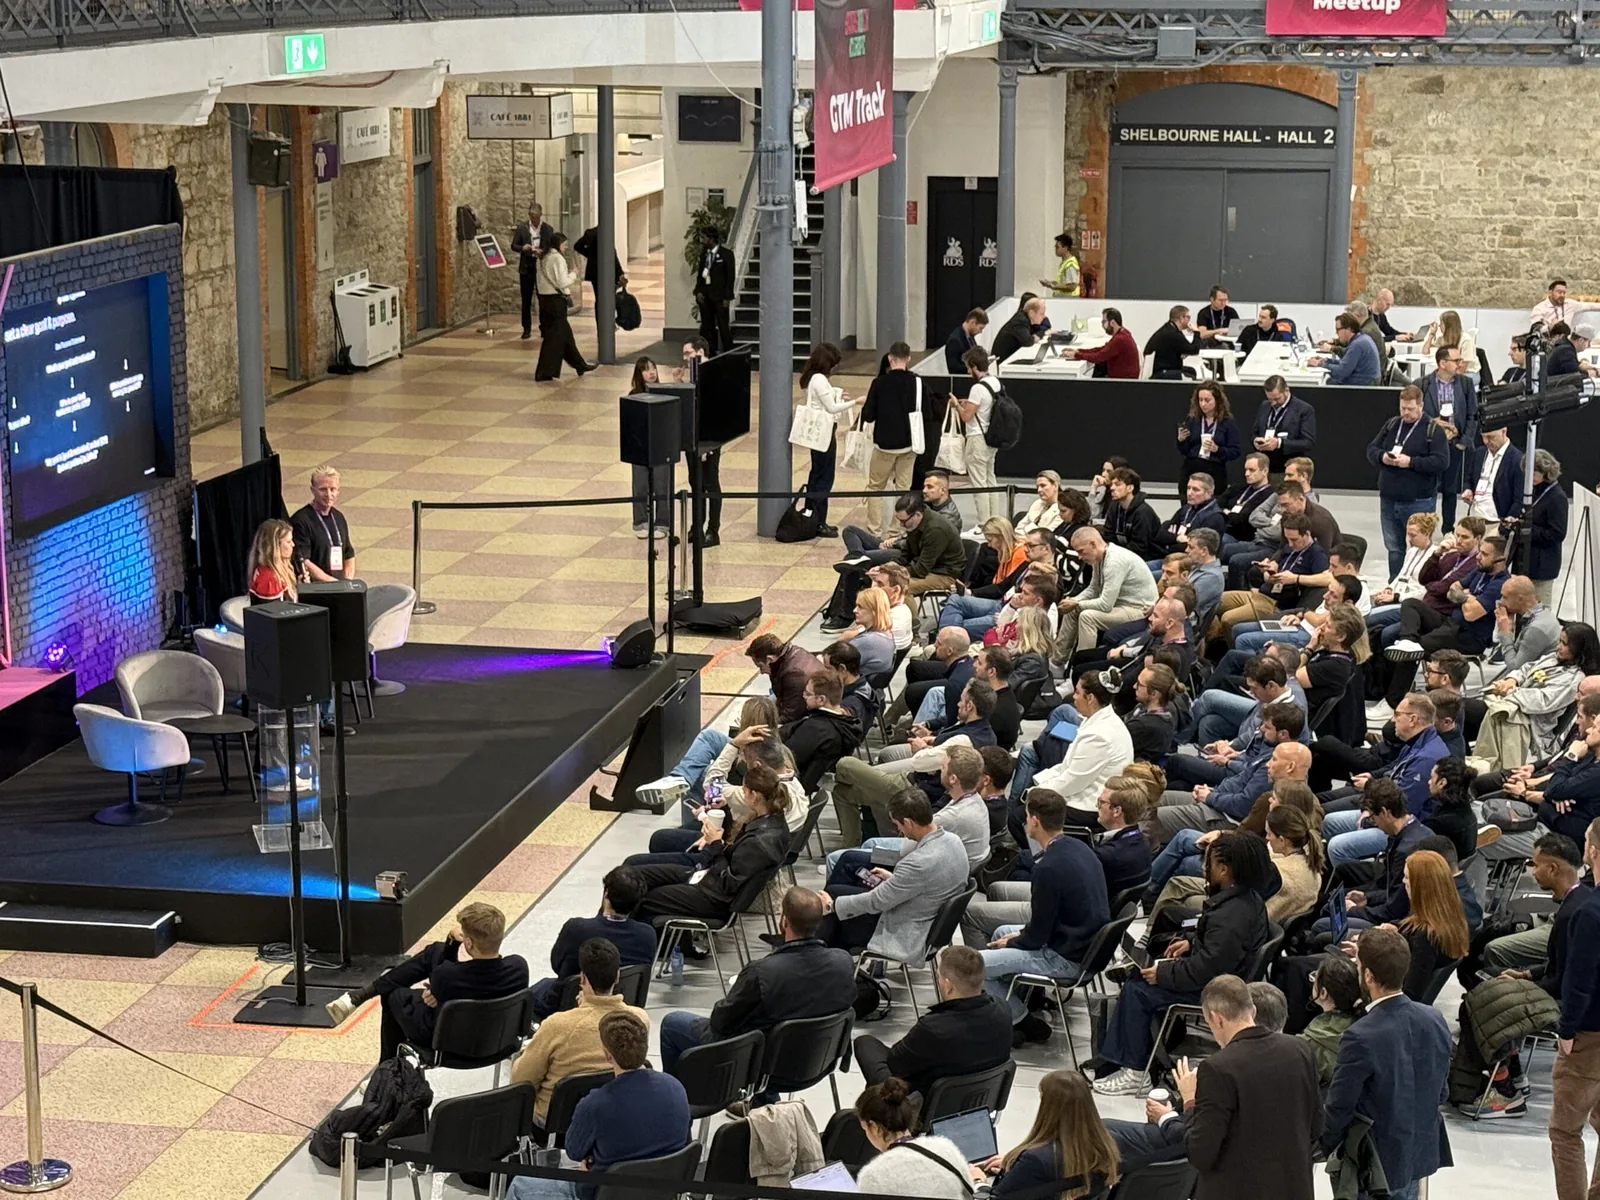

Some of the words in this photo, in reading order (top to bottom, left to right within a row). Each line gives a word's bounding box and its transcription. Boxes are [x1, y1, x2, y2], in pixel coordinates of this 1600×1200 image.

[1313, 0, 1401, 15] Meetup
[829, 90, 854, 134] GTM
[855, 81, 886, 125] Track
[490, 112, 512, 122] CAFÉ
[514, 113, 532, 121] 1881
[1119, 128, 1219, 143] SHELBOURNE
[1223, 129, 1262, 143] HALL
[1278, 130, 1317, 144] HALL
[1323, 128, 1334, 145] 2
[943, 256, 964, 267] RDS
